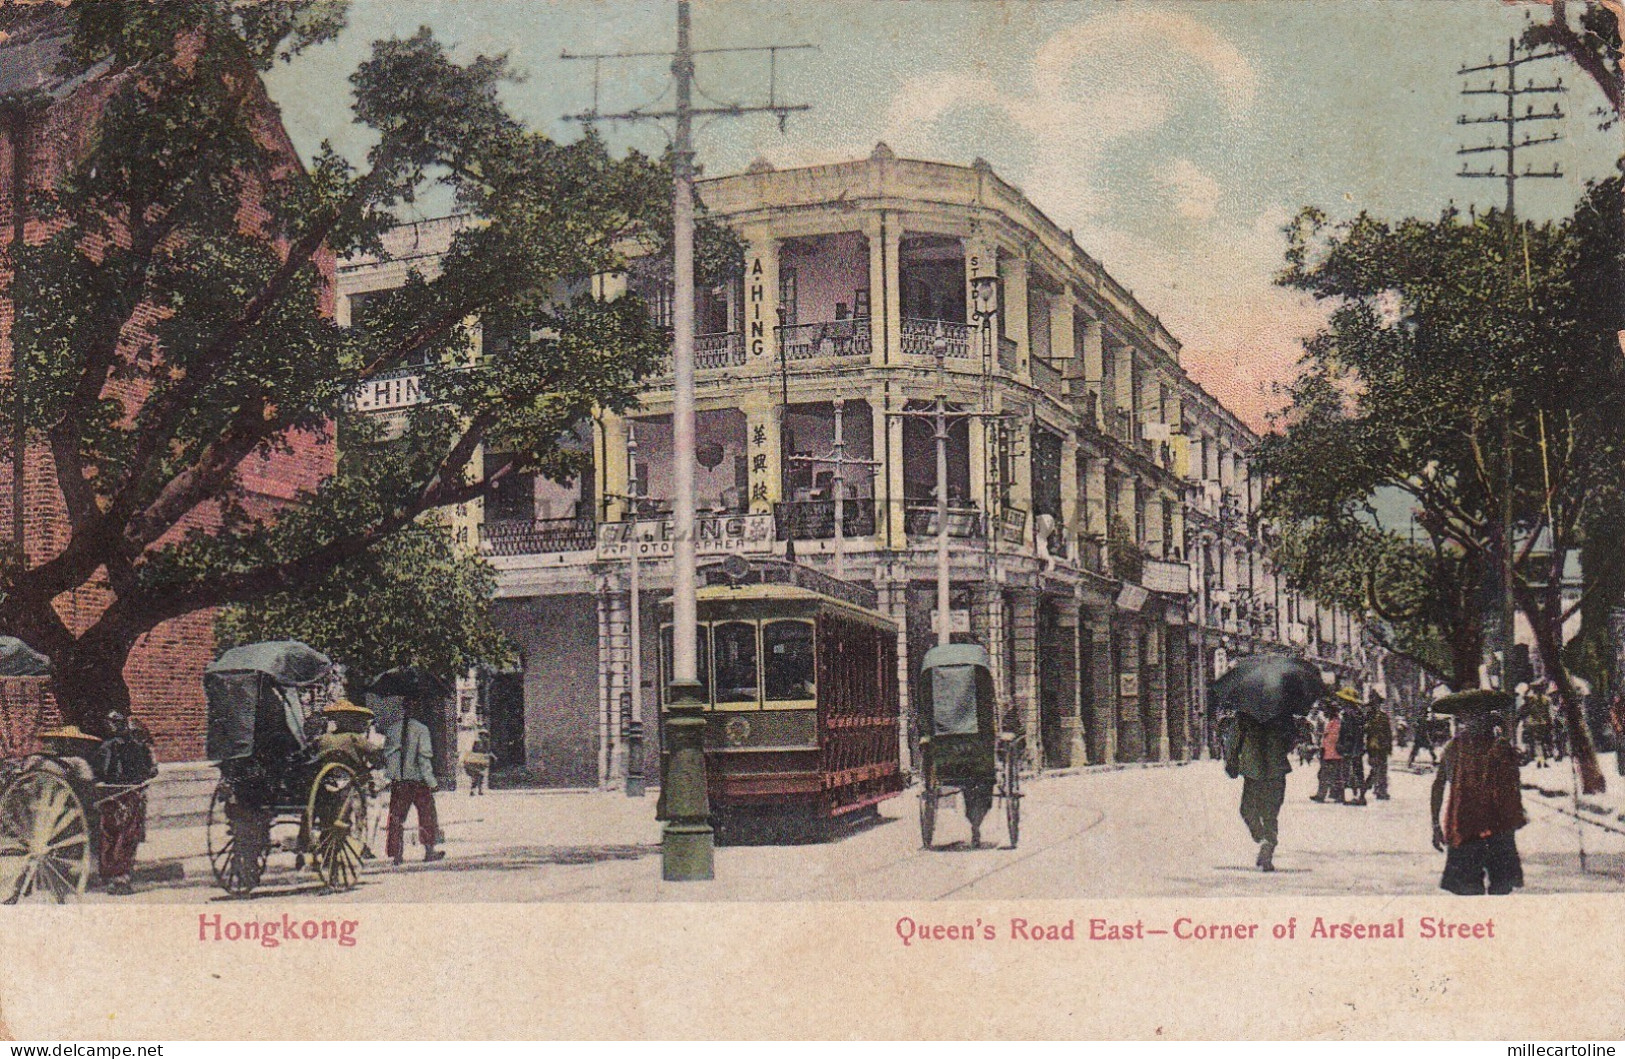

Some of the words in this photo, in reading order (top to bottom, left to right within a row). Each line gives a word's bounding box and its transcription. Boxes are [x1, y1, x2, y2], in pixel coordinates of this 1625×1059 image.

[199, 914, 359, 948] Hongkong
[896, 917, 997, 948] Queen's
[1011, 918, 1076, 942] Road
[1274, 918, 1297, 941] of
[1311, 918, 1406, 941] Arsenal
[1420, 917, 1496, 941] Street
